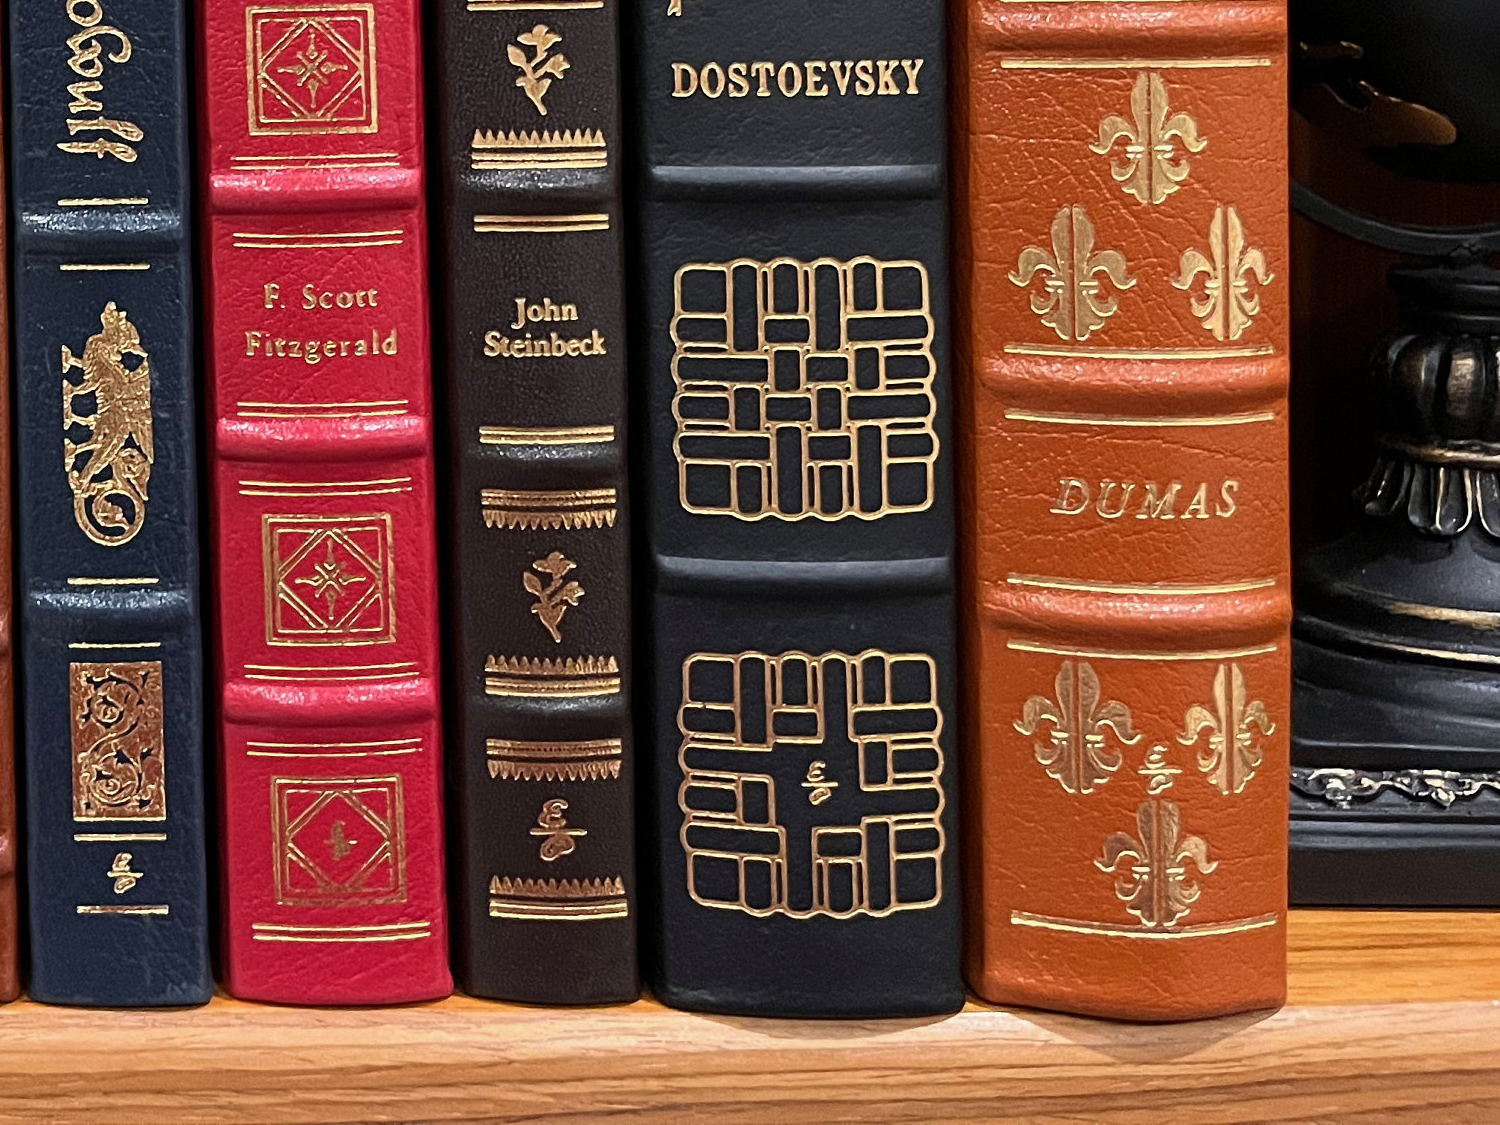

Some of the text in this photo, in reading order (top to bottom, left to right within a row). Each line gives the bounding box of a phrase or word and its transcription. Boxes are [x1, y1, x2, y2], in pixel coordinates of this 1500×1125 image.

[671, 58, 924, 98] DOSTOEVSKY
[263, 282, 378, 310] F. Scott
[510, 296, 579, 330] John
[244, 328, 398, 365] Fitzgerald
[483, 328, 607, 358] Steinbeck
[1049, 477, 1240, 520] DUMAS
